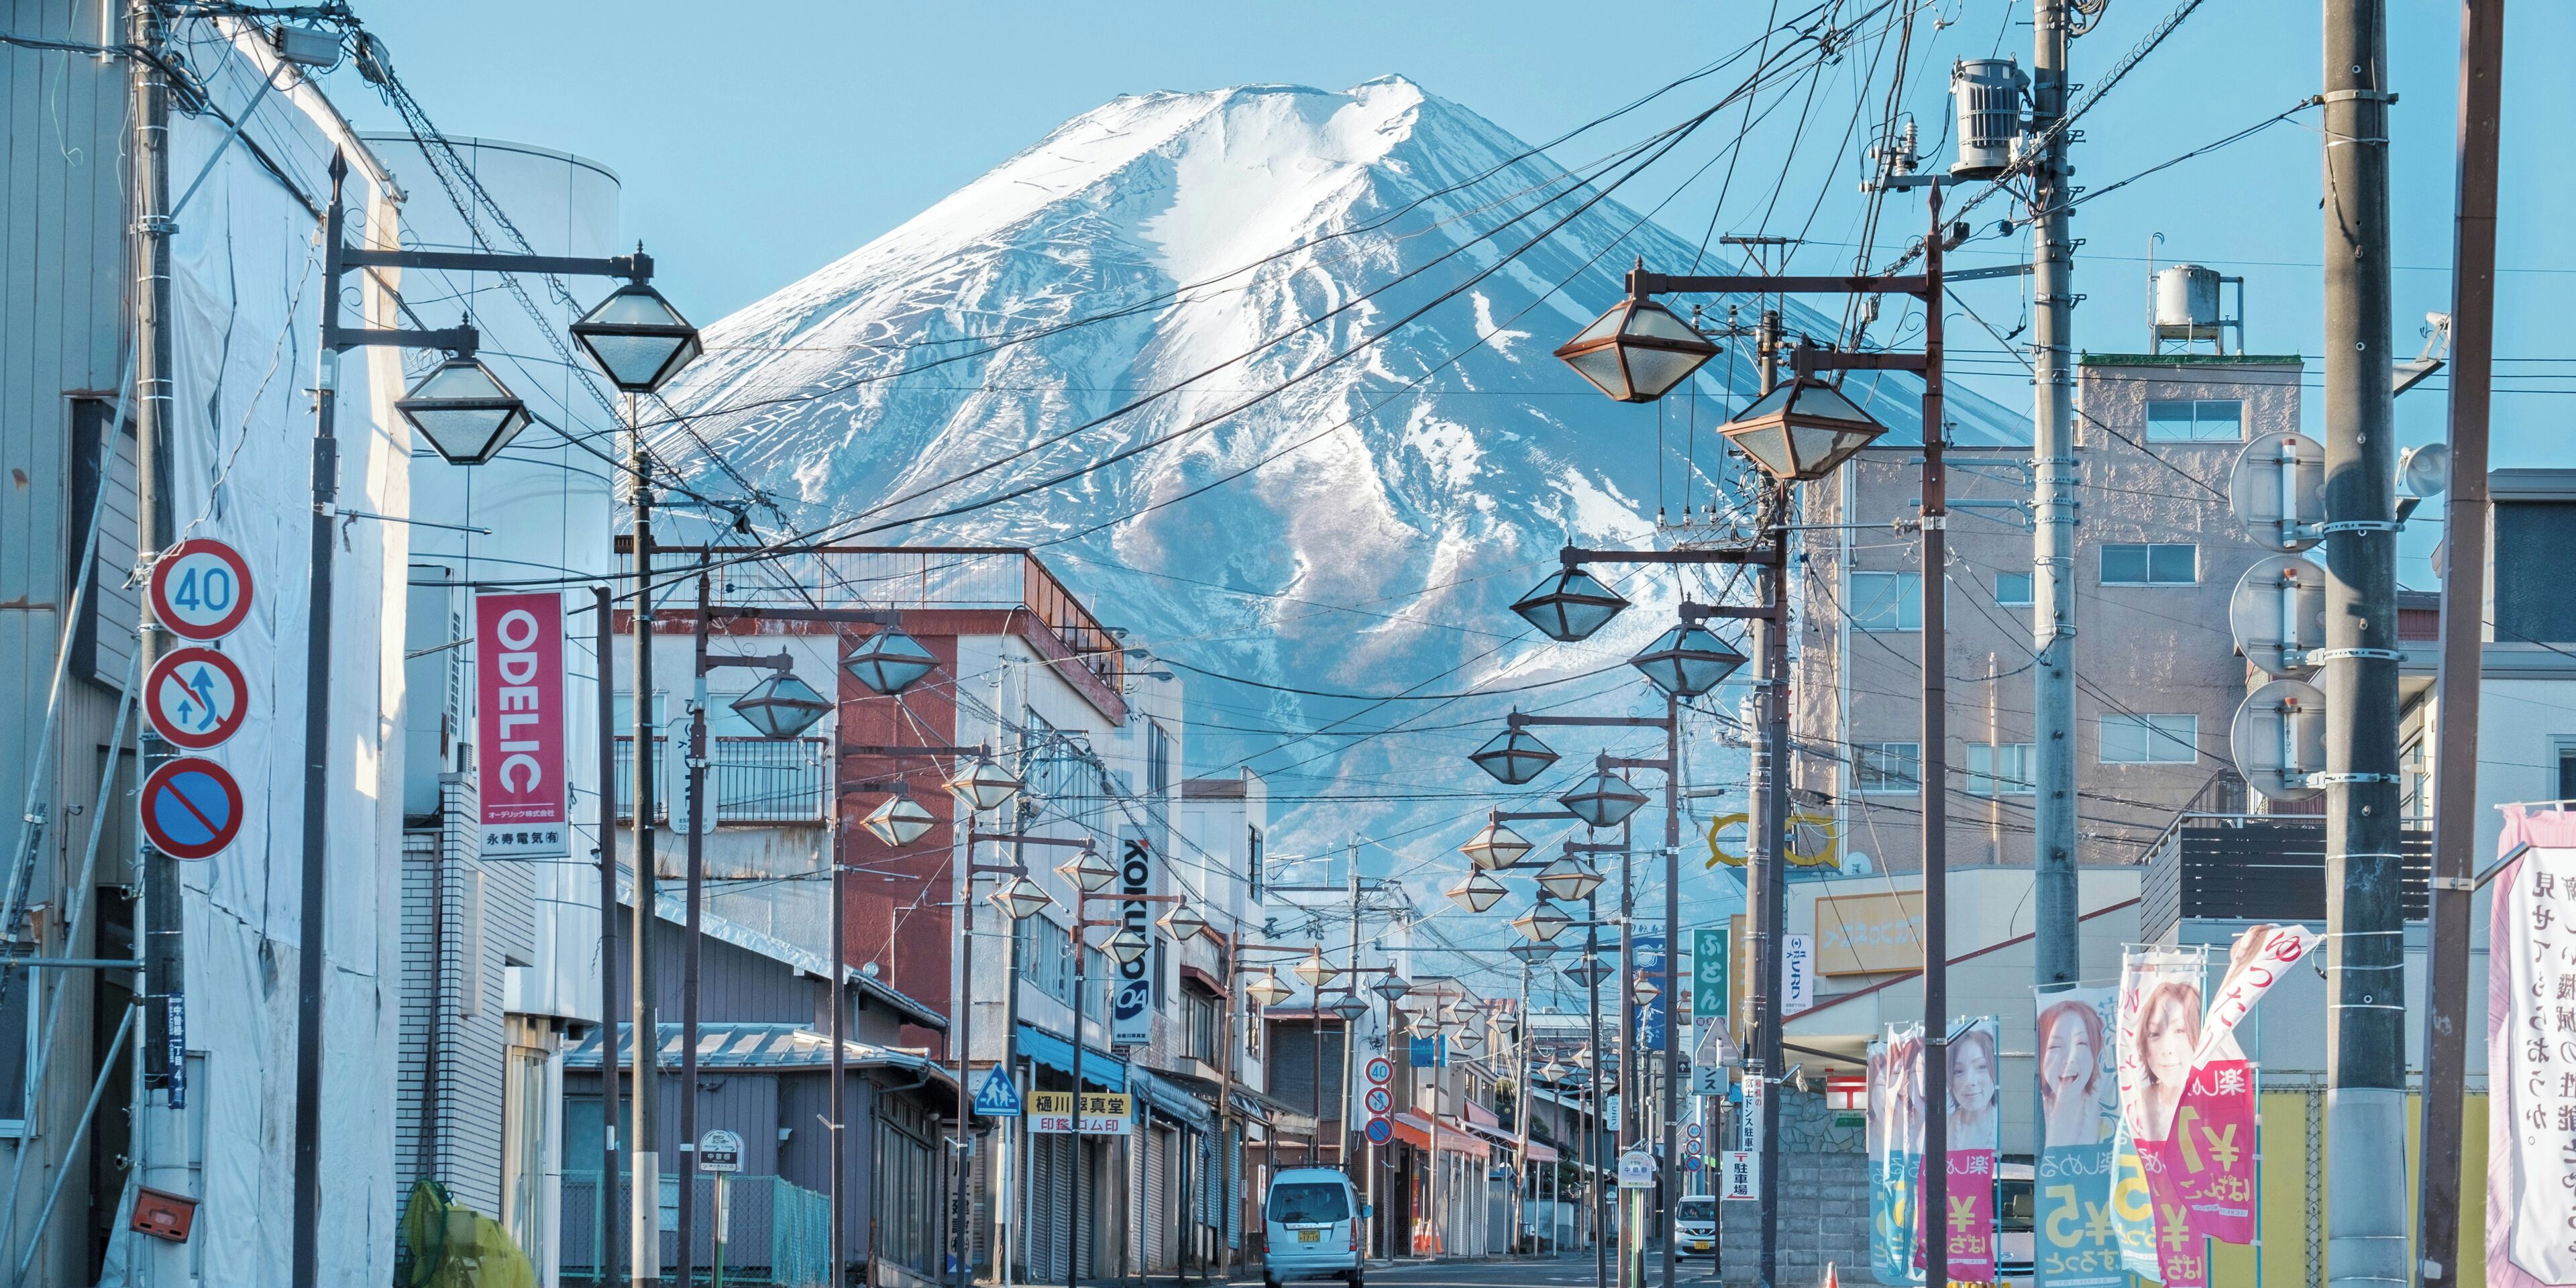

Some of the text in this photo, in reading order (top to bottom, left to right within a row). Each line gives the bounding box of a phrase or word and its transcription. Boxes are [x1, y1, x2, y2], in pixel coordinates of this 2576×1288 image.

[174, 568, 229, 611] 40
[497, 609, 541, 794] ODELIC
[488, 810, 555, 818] オーデリック株式会社
[1120, 839, 1148, 979] KOKUO
[1700, 934, 1721, 1010] ふとん
[1116, 988, 1147, 1008] OA
[2194, 931, 2302, 1059] ゆったり
[174, 1069, 182, 1081] 4
[1372, 1066, 1387, 1077] 40
[1041, 1118, 1069, 1130] 印鑑
[1734, 1163, 1748, 1195] 駐車場
